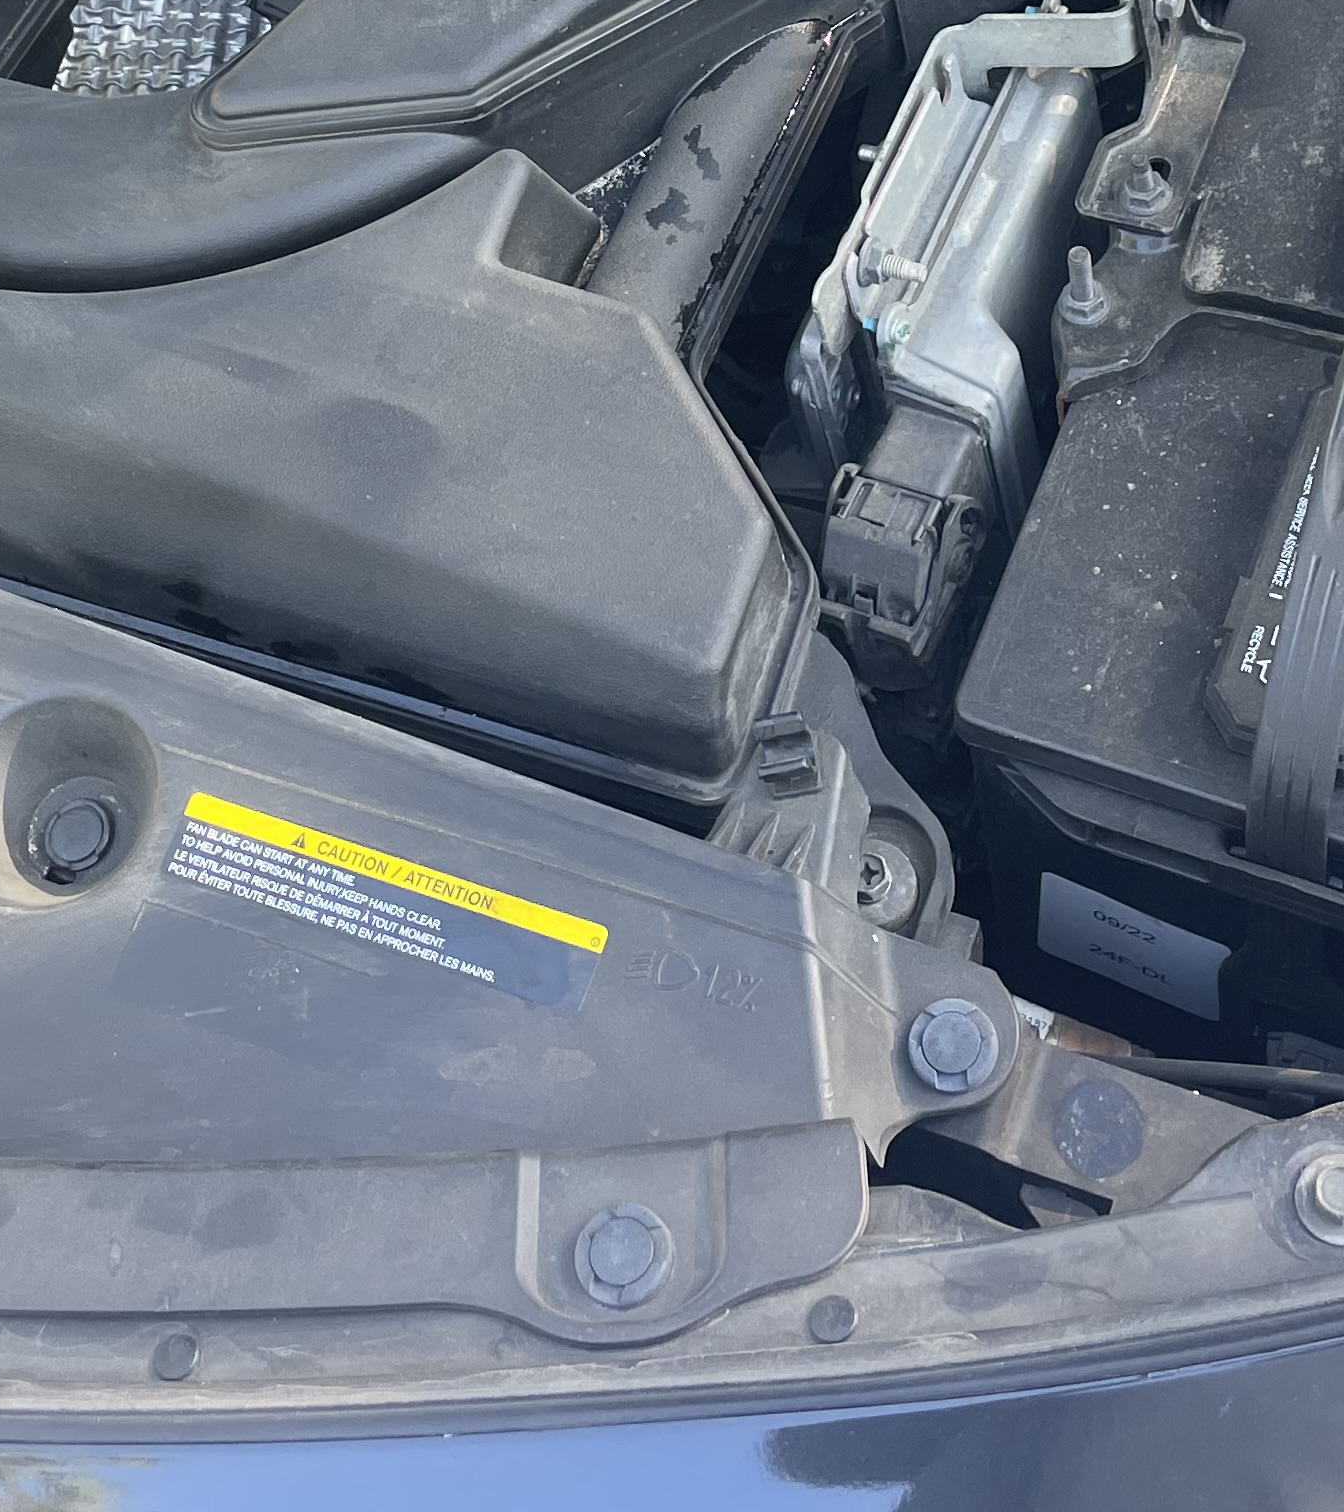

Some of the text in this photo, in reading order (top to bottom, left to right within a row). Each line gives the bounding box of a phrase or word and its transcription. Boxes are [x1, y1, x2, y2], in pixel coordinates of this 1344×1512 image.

[1288, 495, 1309, 532] SERVICE
[1239, 623, 1266, 674] RECYCLE
[182, 834, 196, 847] TO
[195, 839, 222, 856] HELP
[221, 848, 253, 867] AVOID
[254, 858, 305, 885] PERSONAL
[368, 897, 406, 919] HANDS
[186, 821, 207, 838] FAN
[207, 828, 240, 847] BLADE
[240, 839, 263, 855] CAN
[263, 845, 295, 866] START
[294, 856, 308, 869] AT
[307, 862, 329, 880] ANY
[317, 841, 389, 876] CAUTION
[405, 871, 494, 910] ATTENTION
[174, 849, 188, 862] LE
[188, 854, 251, 884] VENTILATEUR
[250, 873, 288, 896] RISQUE
[289, 886, 305, 901] DE
[305, 891, 361, 921] DÉMARRER
[360, 909, 370, 924] À
[371, 915, 399, 933] TOUT
[168, 862, 495, 983] POUR ÉVITER TOUTE BLESSURE, NE PAS EN APPROCHER LES MAINS.
[1091, 908, 1157, 944] 09/22
[1087, 941, 1175, 986] 24F-DL
